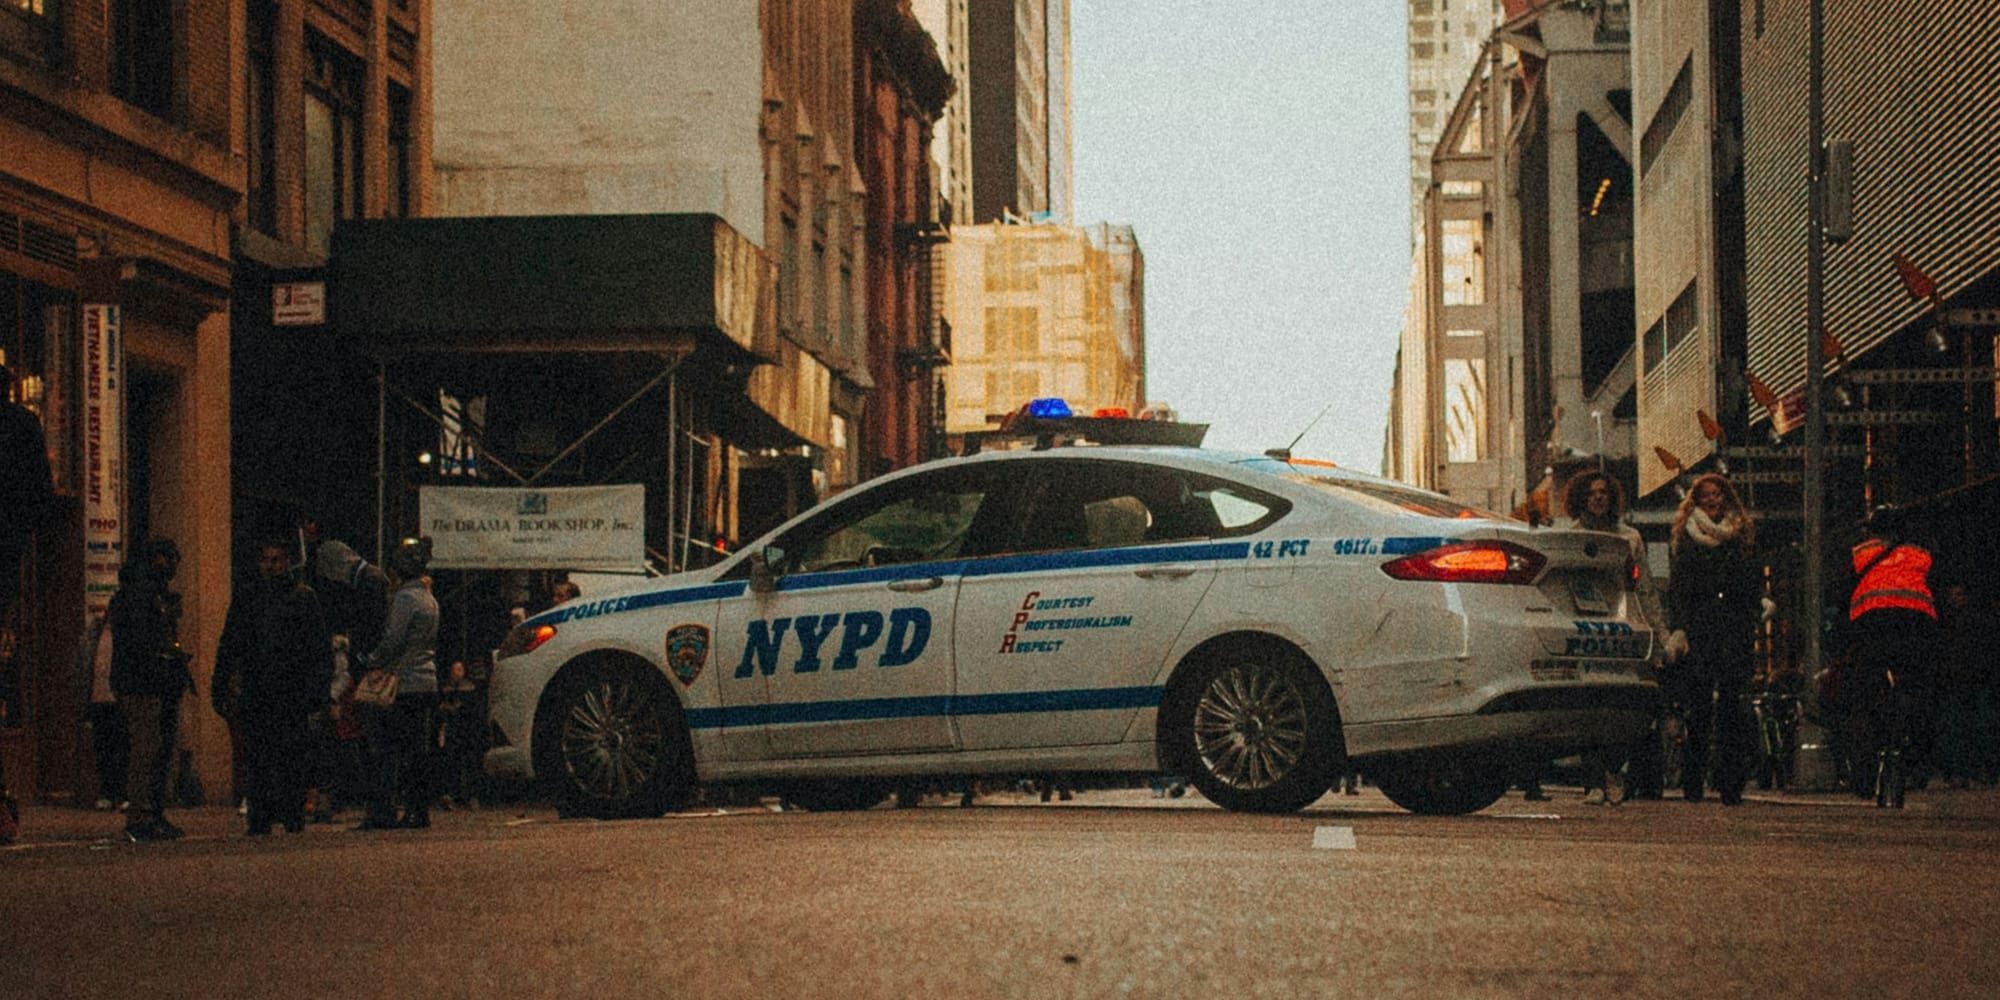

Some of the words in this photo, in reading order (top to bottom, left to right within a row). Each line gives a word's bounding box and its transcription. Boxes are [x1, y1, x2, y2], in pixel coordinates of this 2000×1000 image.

[88, 308, 101, 400] VIETNAMESE
[88, 406, 101, 504] RESTAURANT
[89, 518, 118, 530] PHO
[433, 518, 452, 532] The
[454, 518, 511, 533] DRAMA
[517, 518, 562, 532] BOOK
[1253, 540, 1274, 559] 42
[1278, 539, 1311, 558] PCT
[563, 597, 631, 622] POLICE
[1022, 591, 1095, 611] COURTESY
[1009, 612, 1133, 632] PROFESSIONALISM
[1573, 621, 1633, 636] NYPD
[734, 607, 932, 679] NYPD
[998, 634, 1064, 654] RESPECT
